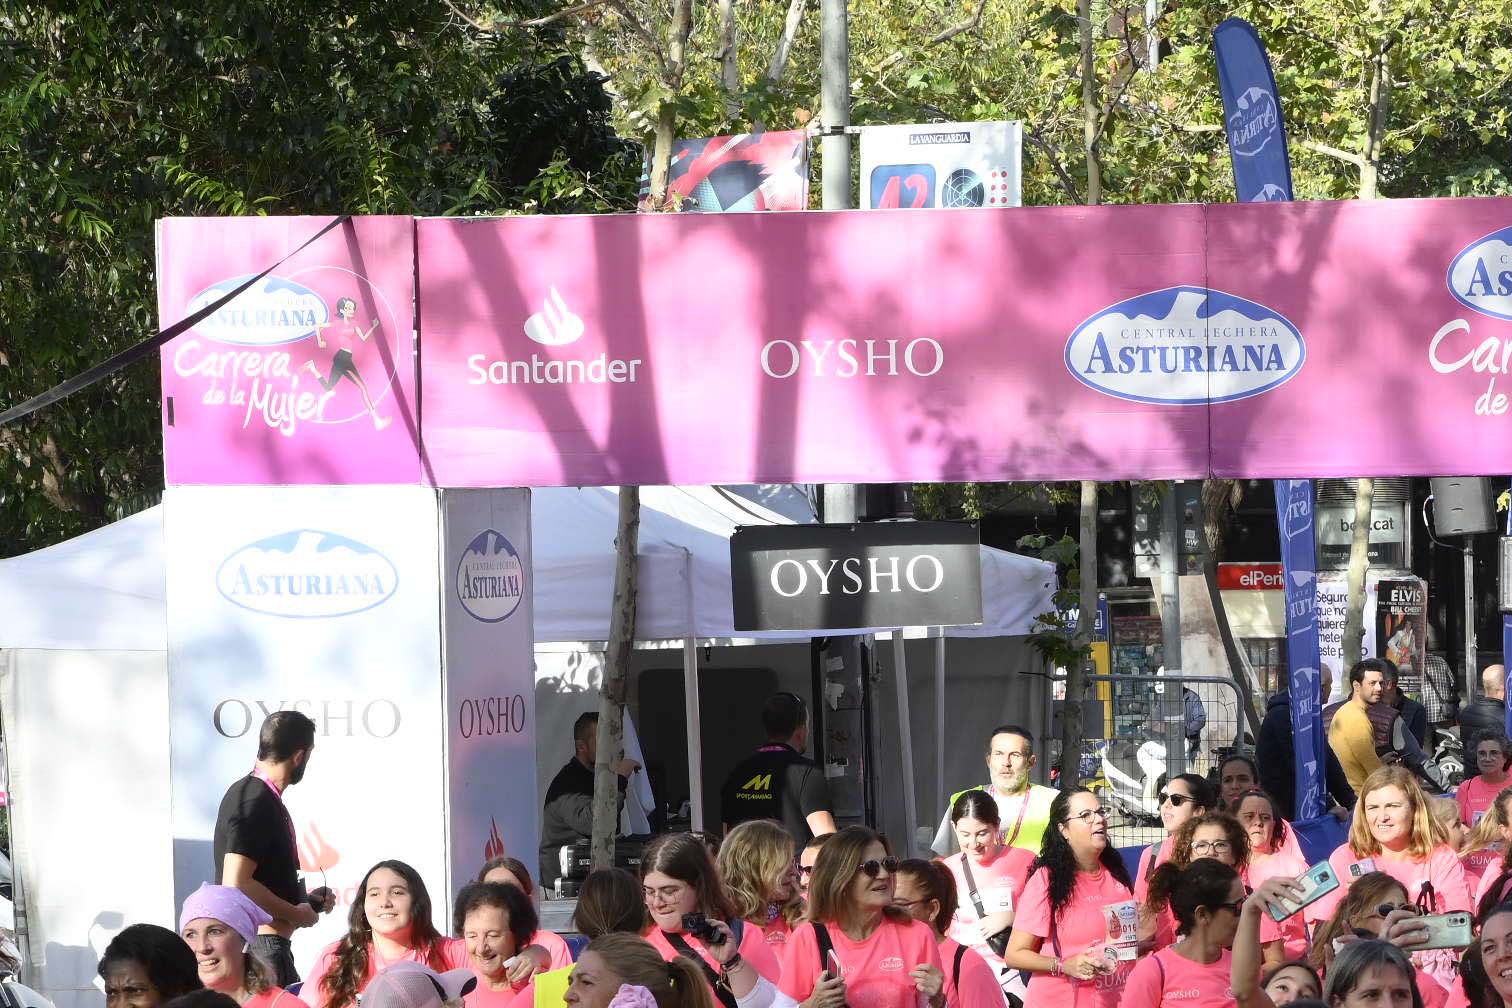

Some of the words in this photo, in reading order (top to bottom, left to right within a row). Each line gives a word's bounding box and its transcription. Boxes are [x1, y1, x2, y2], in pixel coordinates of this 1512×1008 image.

[1121, 327, 1195, 339] CENTRAL
[1203, 325, 1278, 339] LECHERA
[174, 340, 291, 377] Carrera
[469, 352, 641, 385] Santander
[761, 336, 944, 379] OYSHO
[1084, 331, 1287, 375] ASTURIANA
[203, 380, 224, 406] de
[230, 377, 246, 405] la
[243, 374, 336, 437] Mujer
[1474, 376, 1510, 416] de
[231, 563, 385, 596] ASTURIANA
[462, 568, 520, 600] ASTURIANA
[770, 554, 944, 598] OYSHO
[1390, 589, 1422, 602] ELVIS
[459, 693, 526, 740] OYSHO
[1471, 856, 1492, 865] SUM
[1166, 989, 1200, 1000] OYSHO
